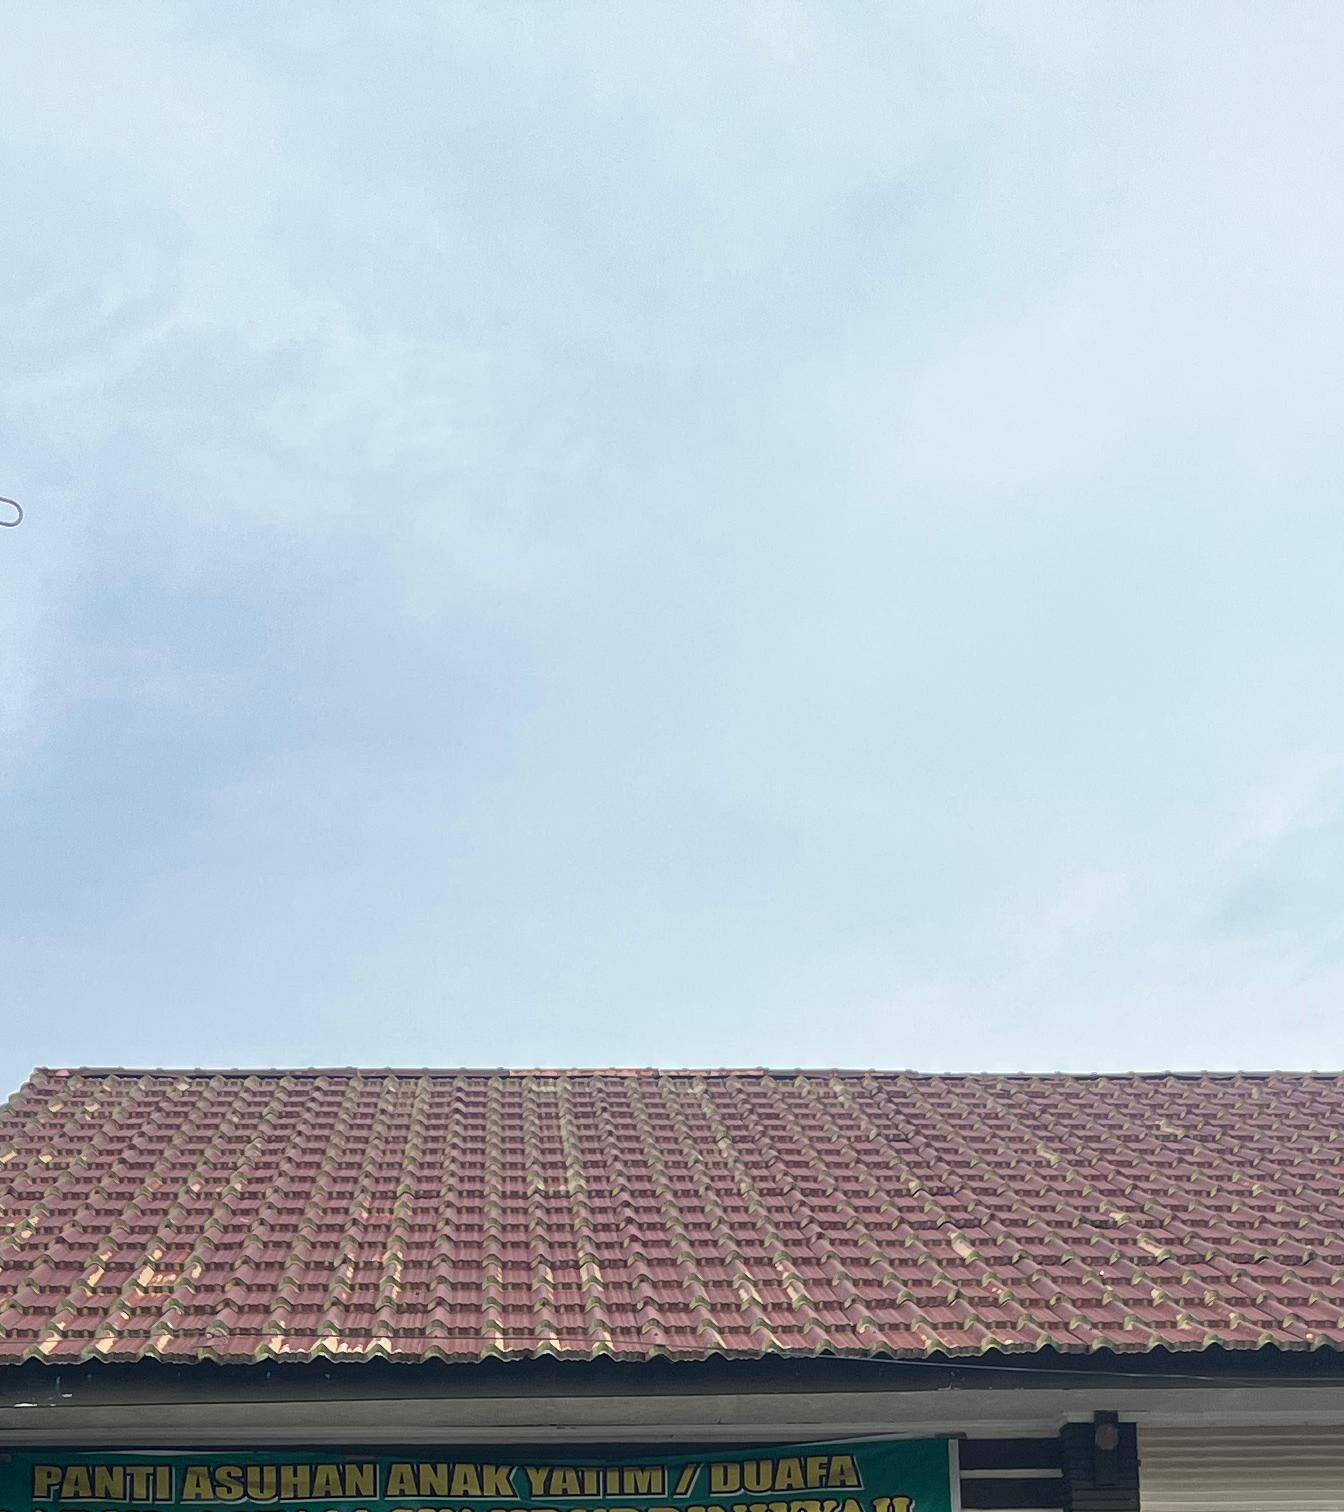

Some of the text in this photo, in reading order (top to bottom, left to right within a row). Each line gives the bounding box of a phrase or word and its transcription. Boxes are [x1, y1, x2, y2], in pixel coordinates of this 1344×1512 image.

[33, 1454, 864, 1503] PANTI ASUHAN ANAK YATIM / DUAFA
